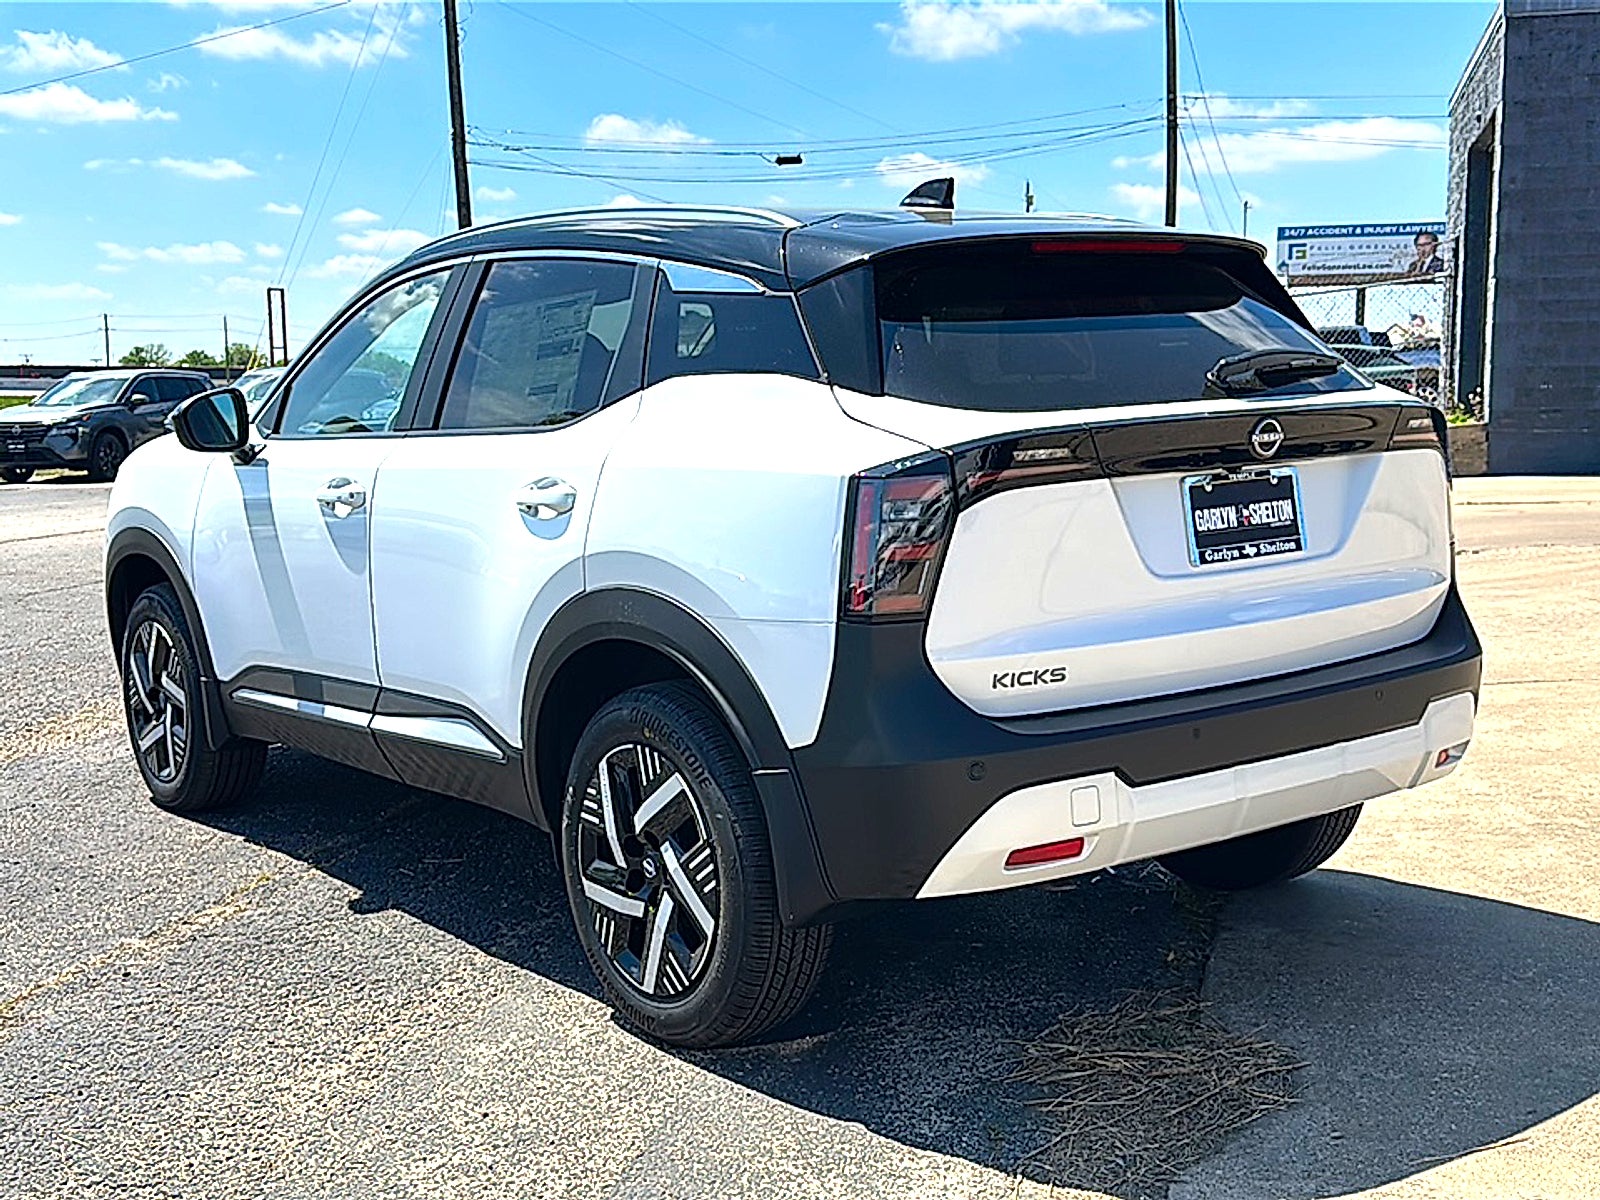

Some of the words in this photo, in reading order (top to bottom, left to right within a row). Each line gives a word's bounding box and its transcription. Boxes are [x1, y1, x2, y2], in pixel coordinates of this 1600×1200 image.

[1283, 228, 1306, 237] 24/7
[1307, 226, 1354, 236] ACCIDENT
[1355, 226, 1362, 234] &
[1363, 225, 1398, 234] INJURY
[1399, 224, 1445, 233] LAWYERS
[1194, 505, 1238, 531] GARLYN
[1248, 499, 1294, 525] SHELTON
[1204, 549, 1240, 562] Garlyn
[1259, 541, 1296, 554] Shelton
[992, 667, 1067, 690] KICKS
